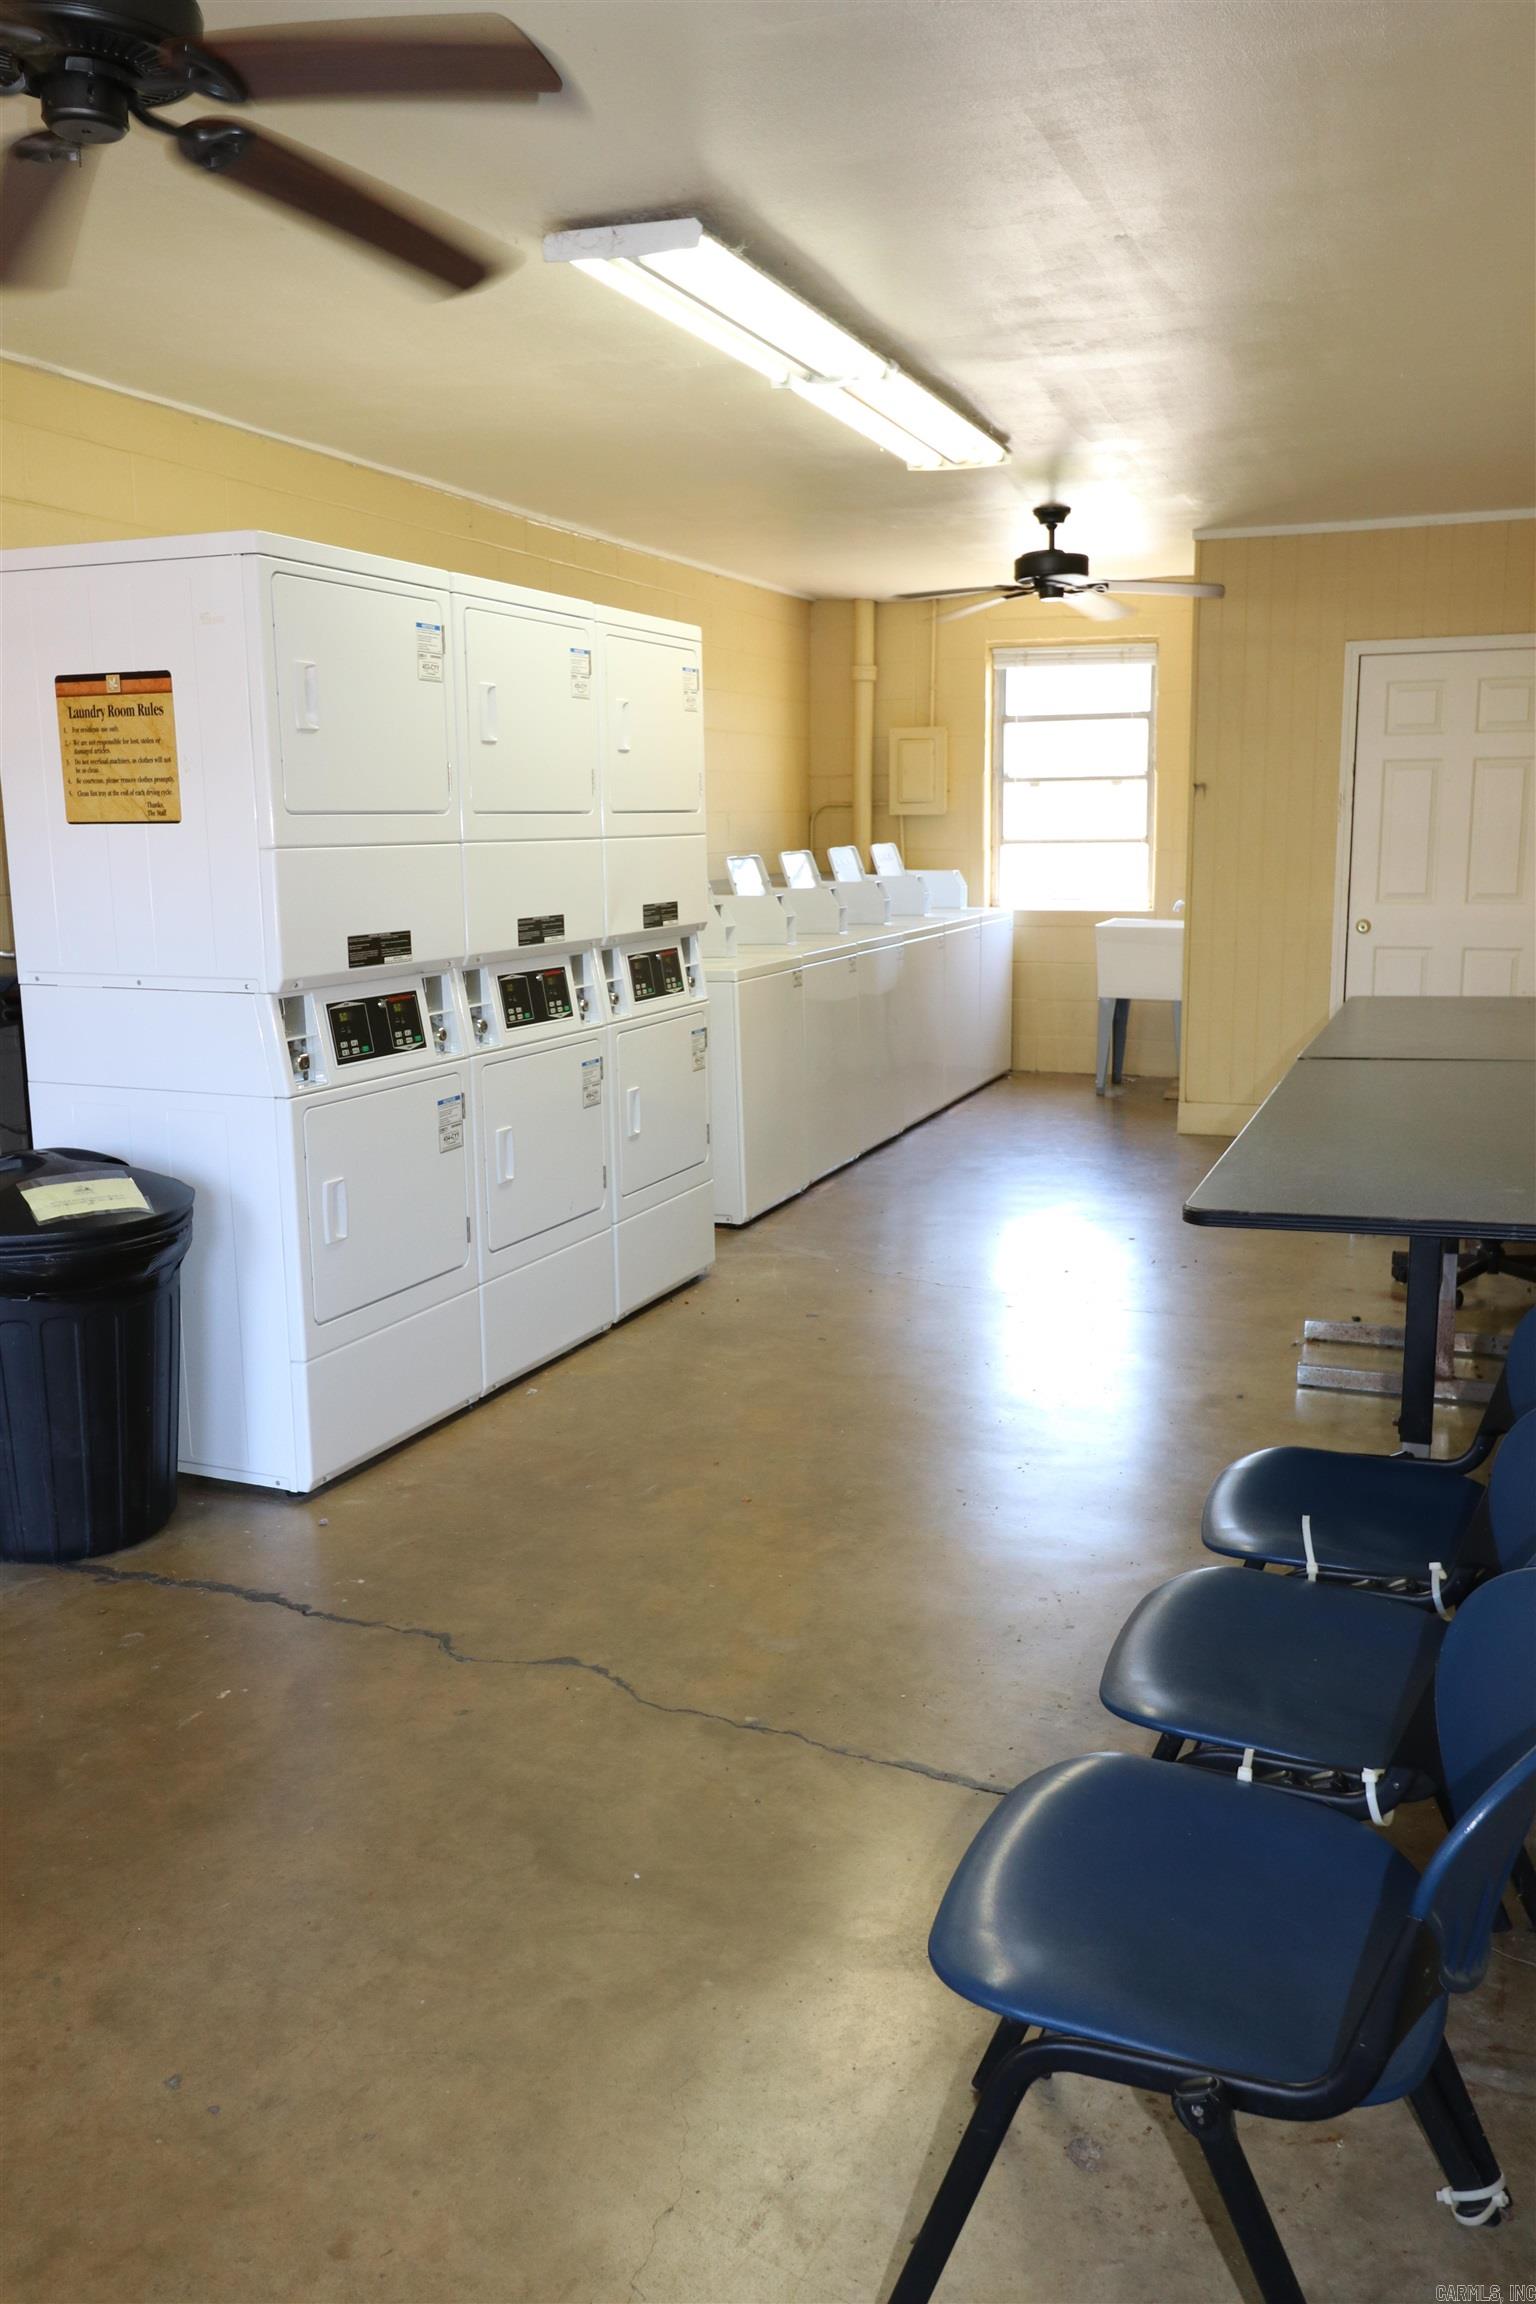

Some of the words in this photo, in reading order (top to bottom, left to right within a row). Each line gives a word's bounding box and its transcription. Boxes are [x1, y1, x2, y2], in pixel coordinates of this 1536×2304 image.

[67, 704, 104, 722] Laundry
[107, 704, 135, 718] Room
[137, 702, 164, 717] Rules
